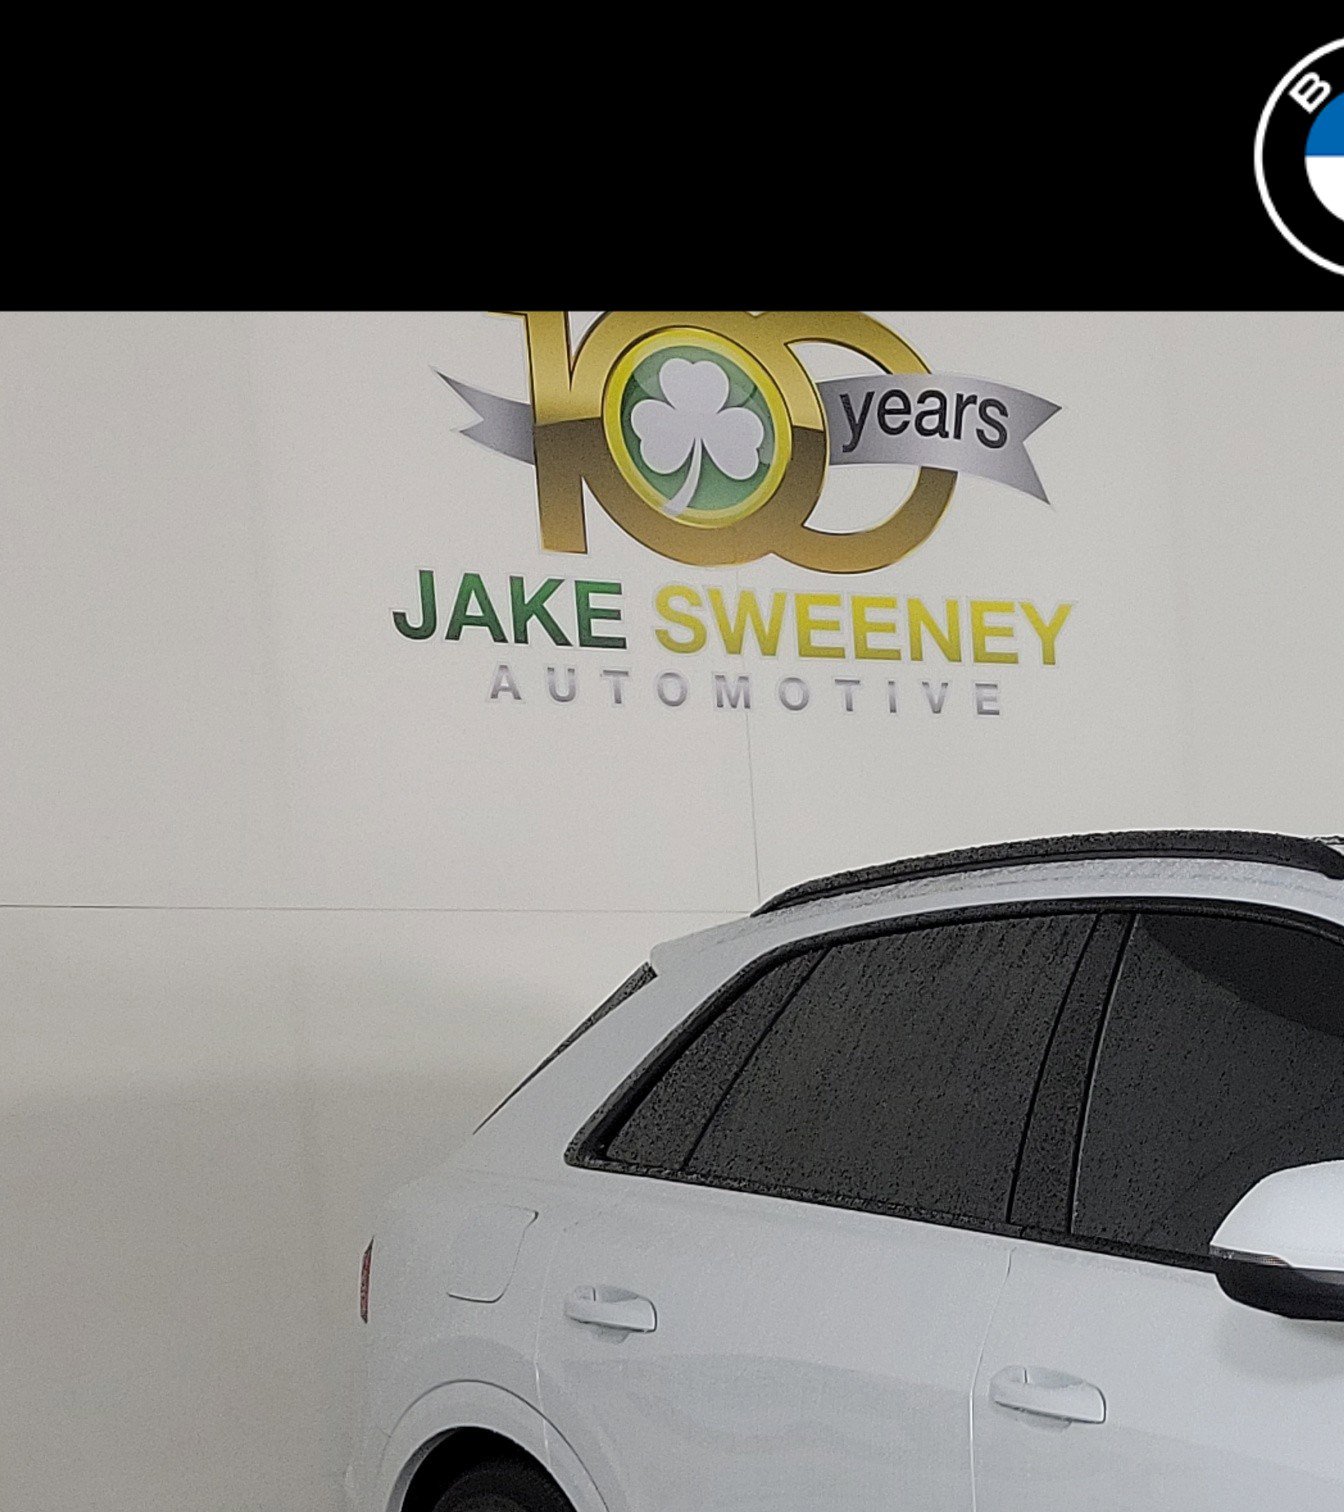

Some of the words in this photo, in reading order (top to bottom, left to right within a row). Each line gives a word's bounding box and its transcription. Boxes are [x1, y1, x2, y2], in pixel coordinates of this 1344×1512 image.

[838, 388, 1009, 450] years
[391, 570, 627, 650] JAKE
[653, 584, 1072, 666] SWEENEY
[489, 665, 1001, 716] AUTOMOTIVE
